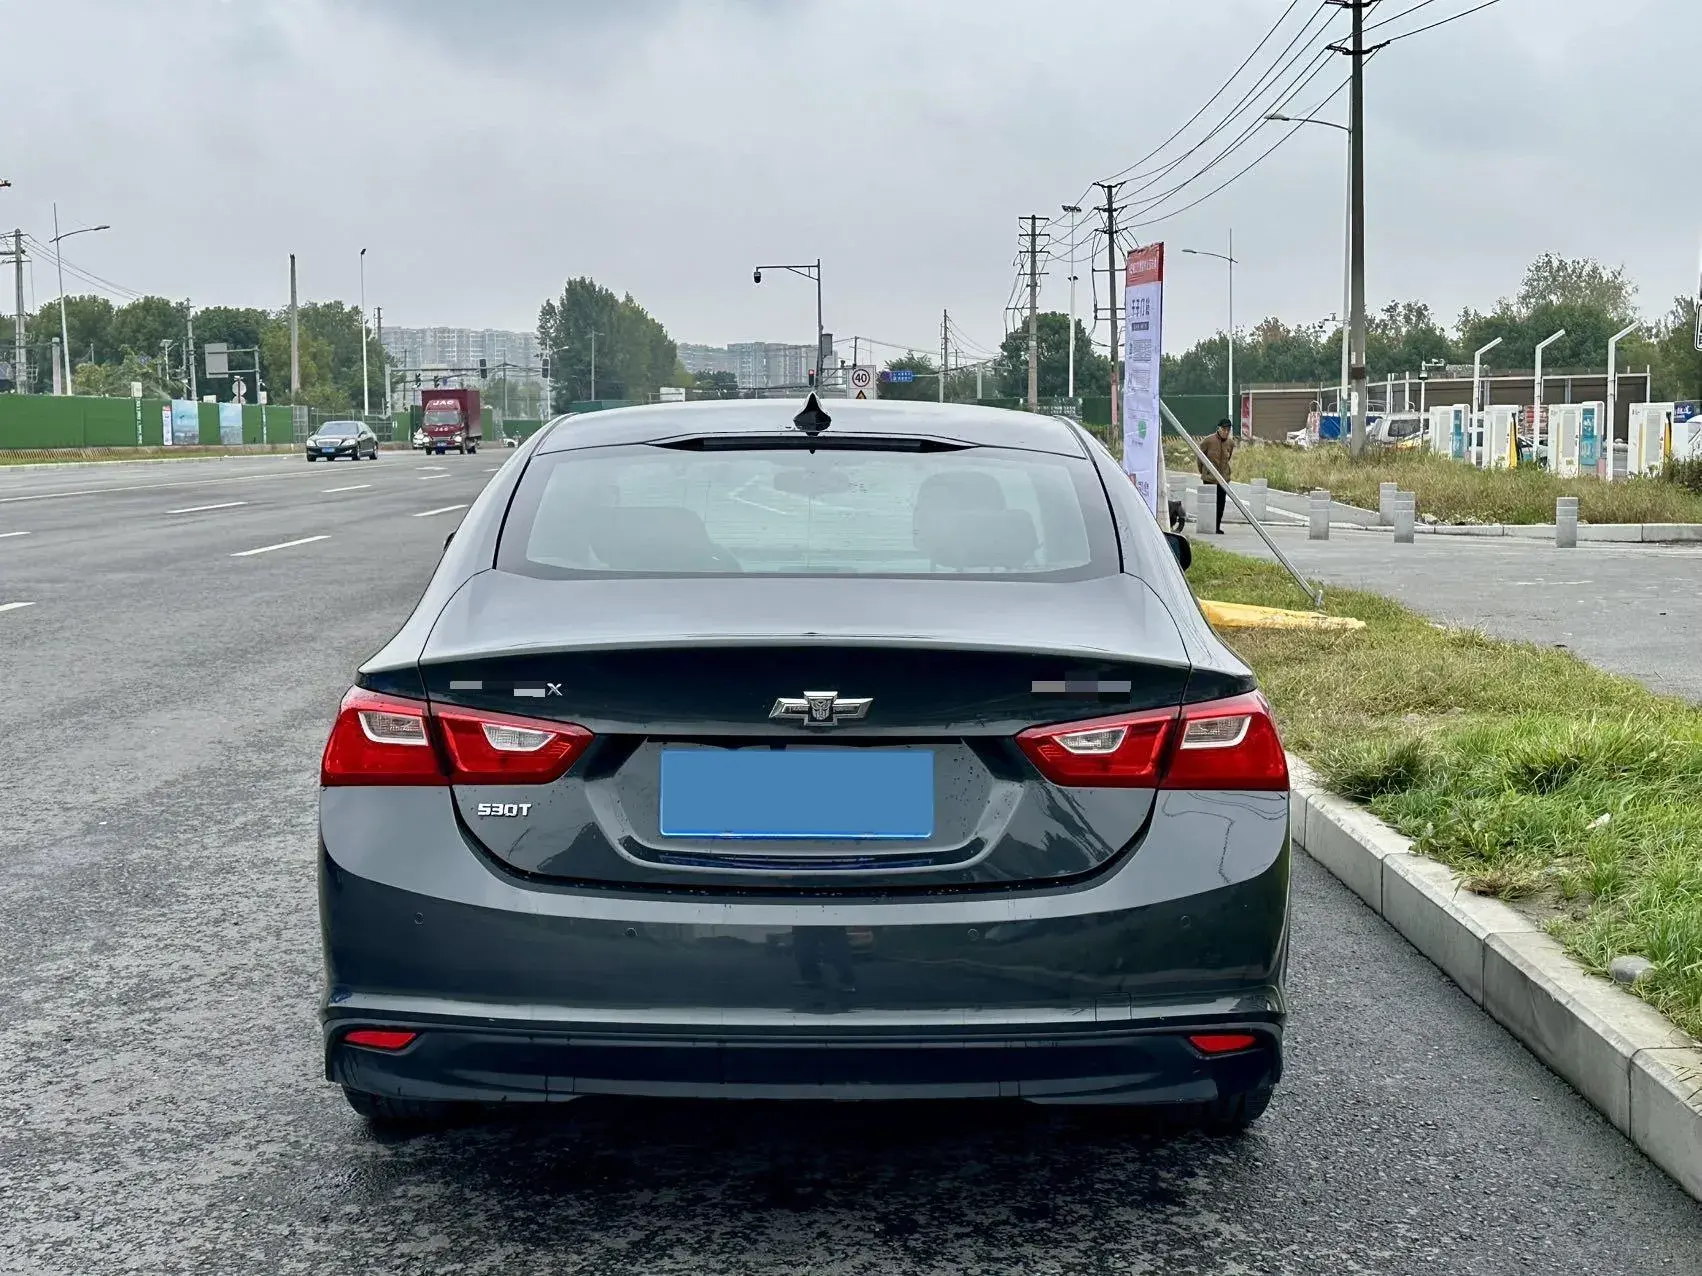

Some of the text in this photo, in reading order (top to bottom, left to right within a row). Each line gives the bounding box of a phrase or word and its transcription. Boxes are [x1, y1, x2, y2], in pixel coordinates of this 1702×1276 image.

[855, 373, 867, 383] 40
[547, 683, 563, 696] X
[477, 803, 532, 817] 530T
